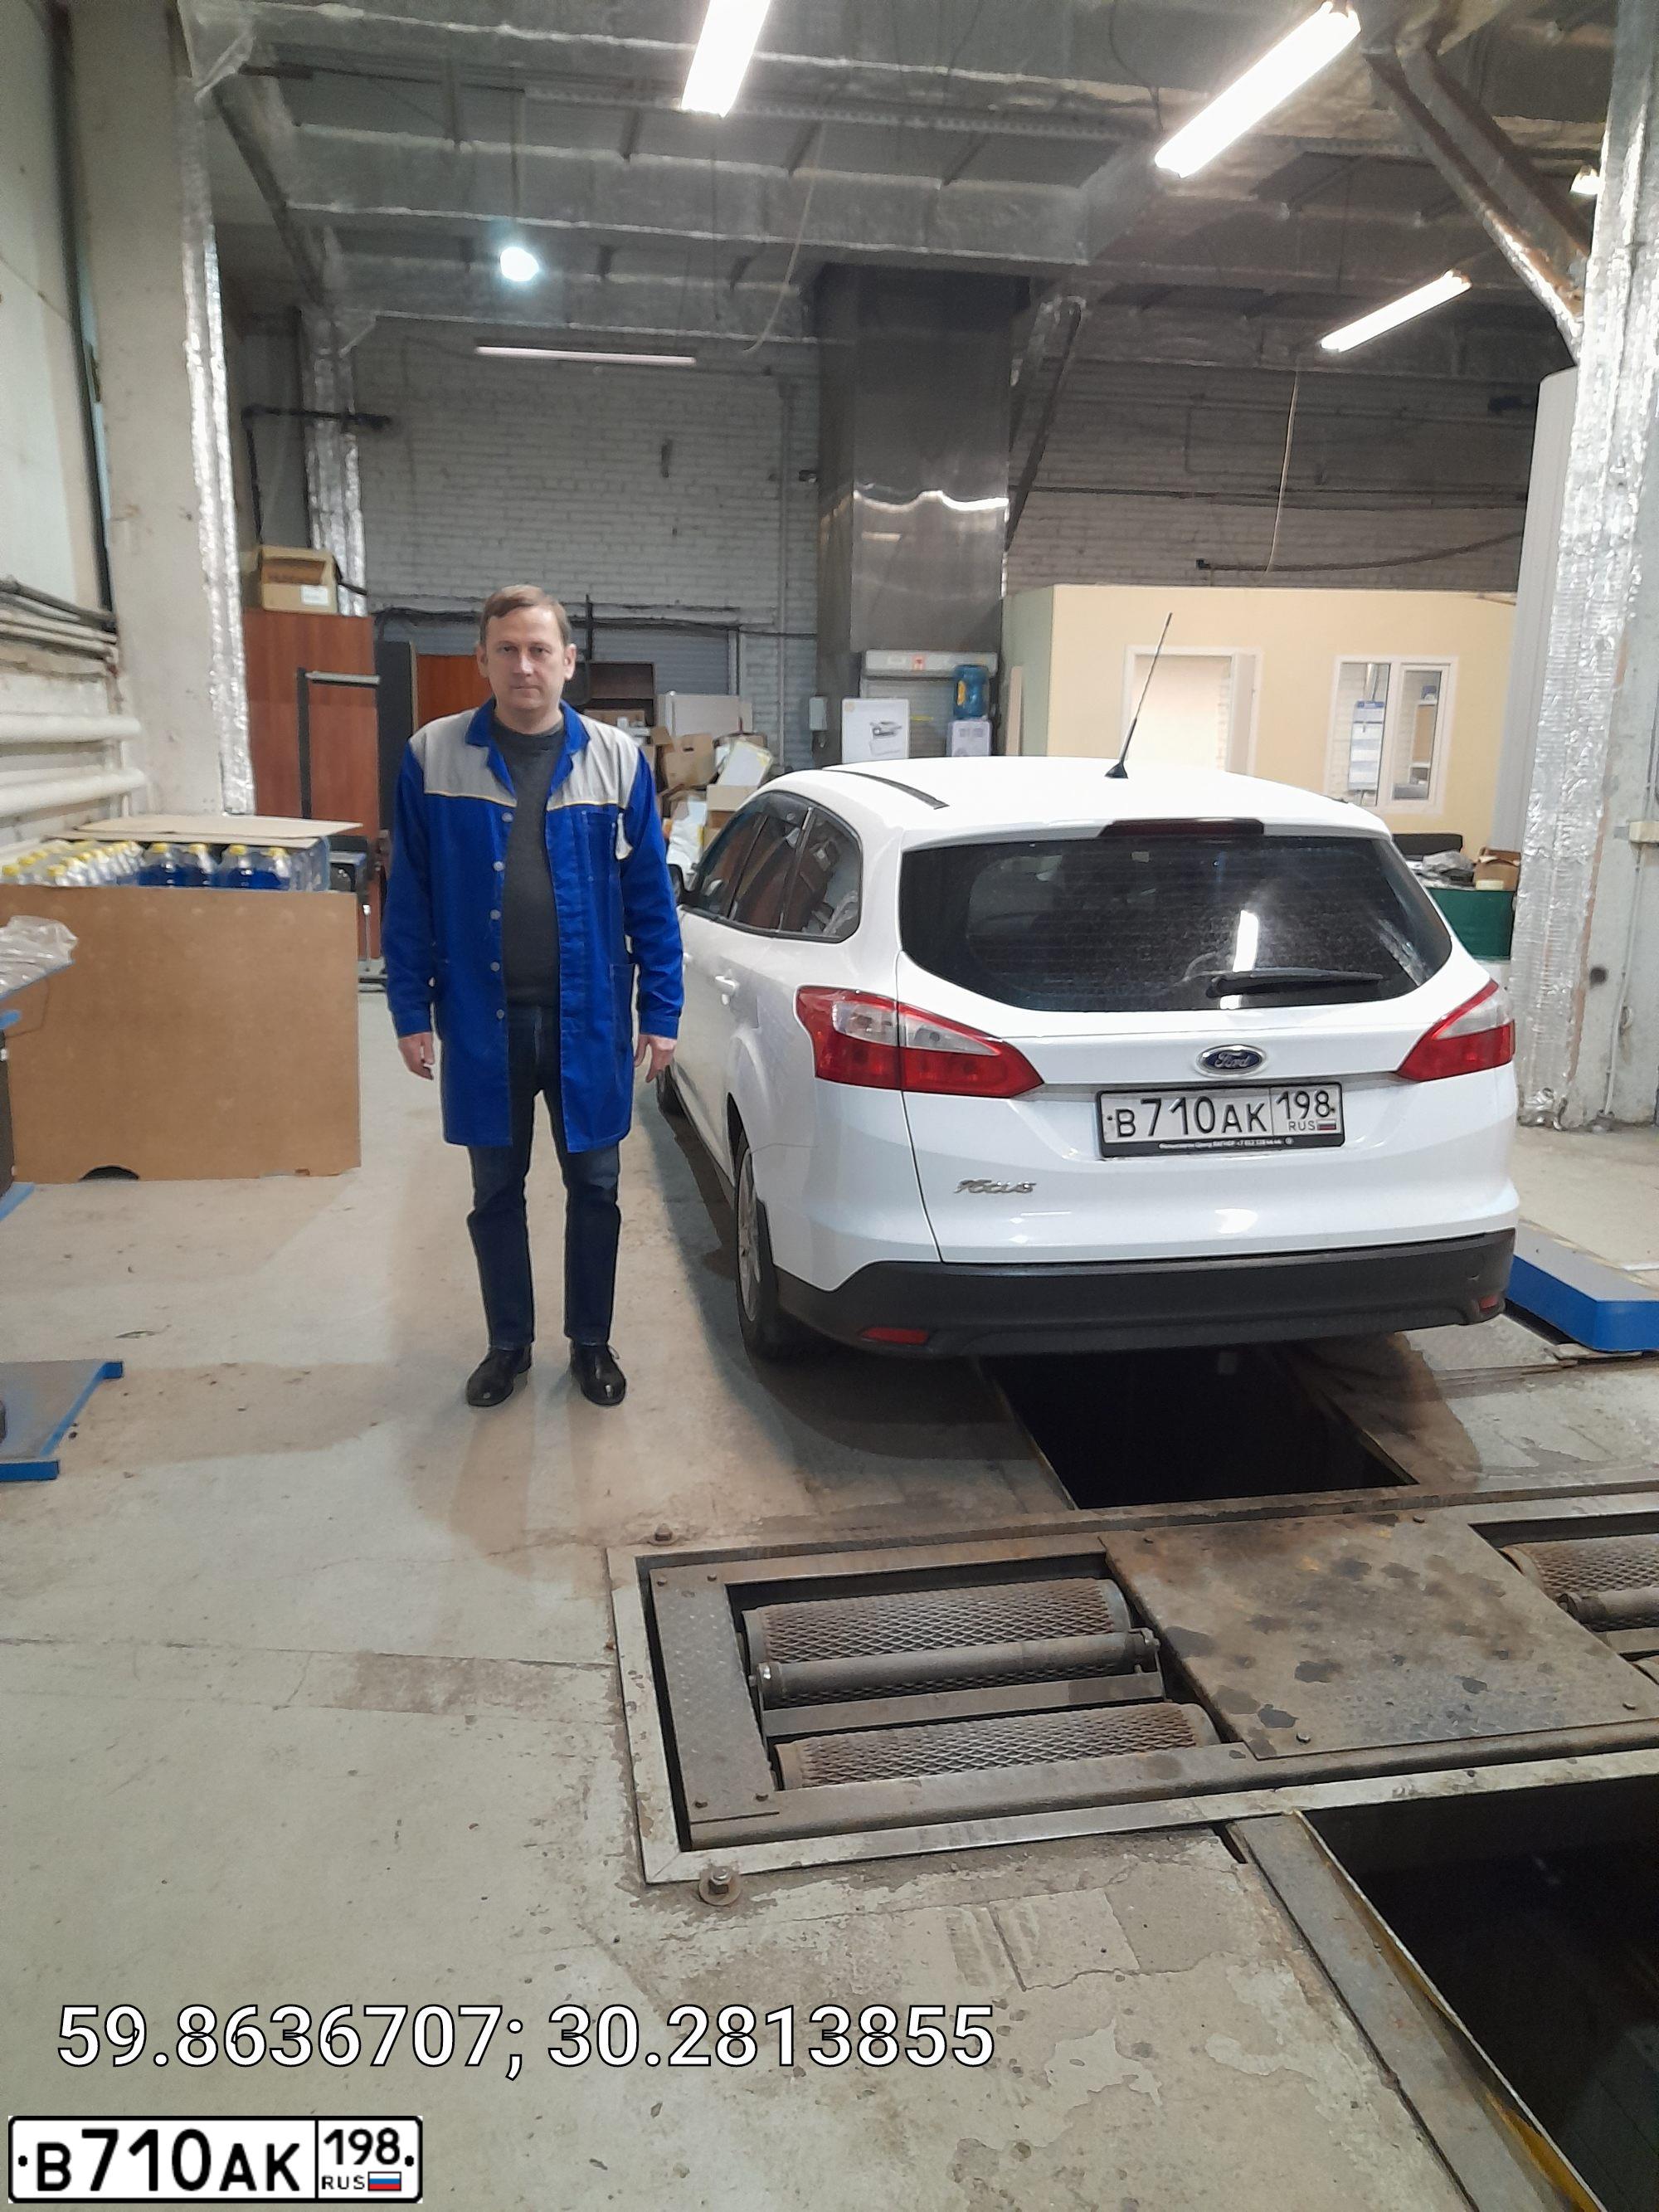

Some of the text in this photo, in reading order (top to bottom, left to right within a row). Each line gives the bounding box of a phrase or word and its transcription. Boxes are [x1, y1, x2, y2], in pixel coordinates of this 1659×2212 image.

[1214, 1051, 1250, 1068] Ford
[1276, 1090, 1331, 1119] 198
[1288, 1120, 1316, 1131] RUS
